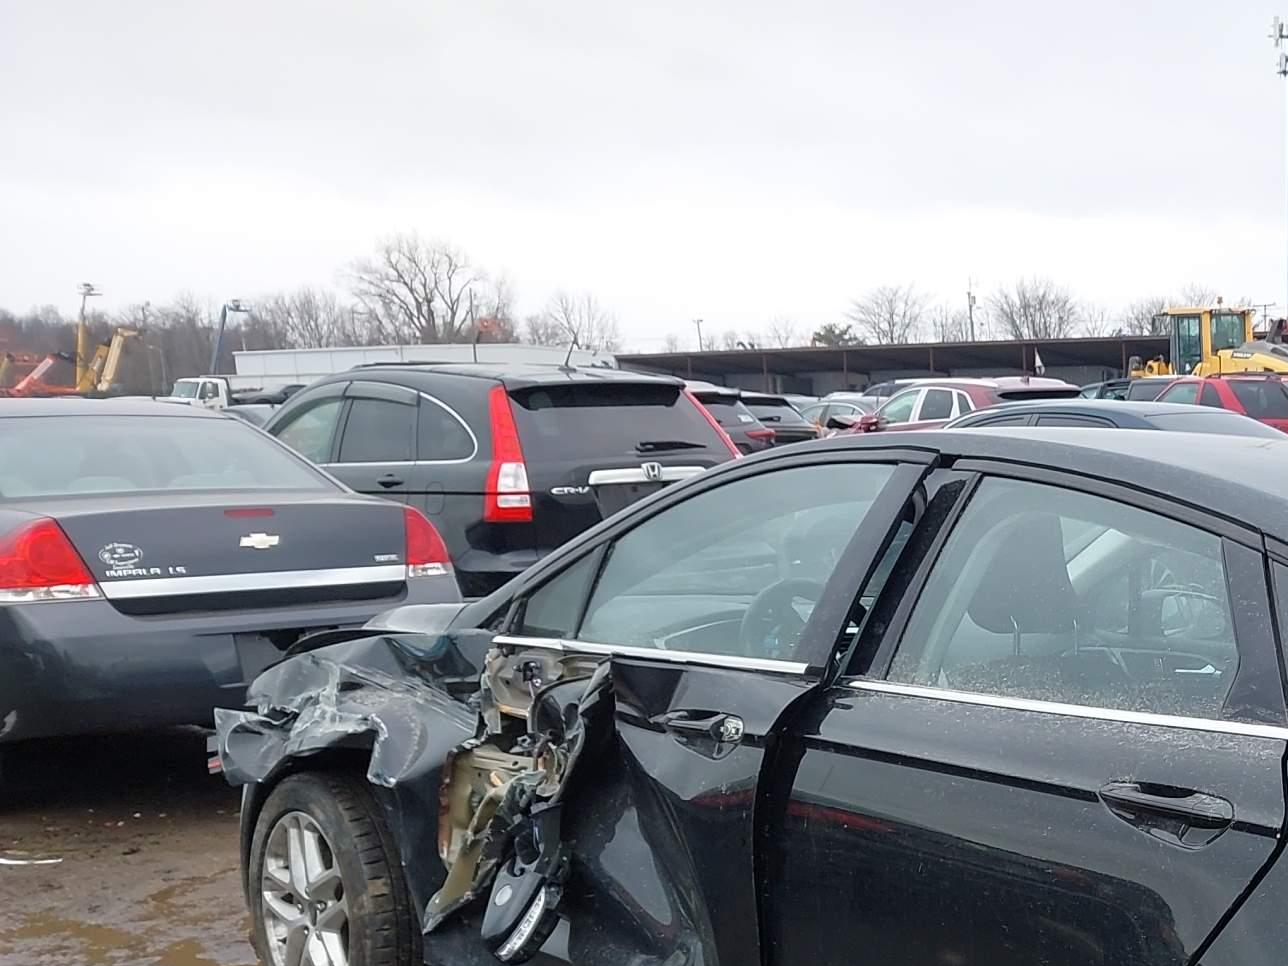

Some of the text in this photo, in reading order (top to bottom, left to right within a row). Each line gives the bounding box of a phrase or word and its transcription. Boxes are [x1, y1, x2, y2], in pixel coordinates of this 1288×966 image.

[550, 486, 589, 495] CR-V
[105, 566, 186, 577] IMPALA LS
